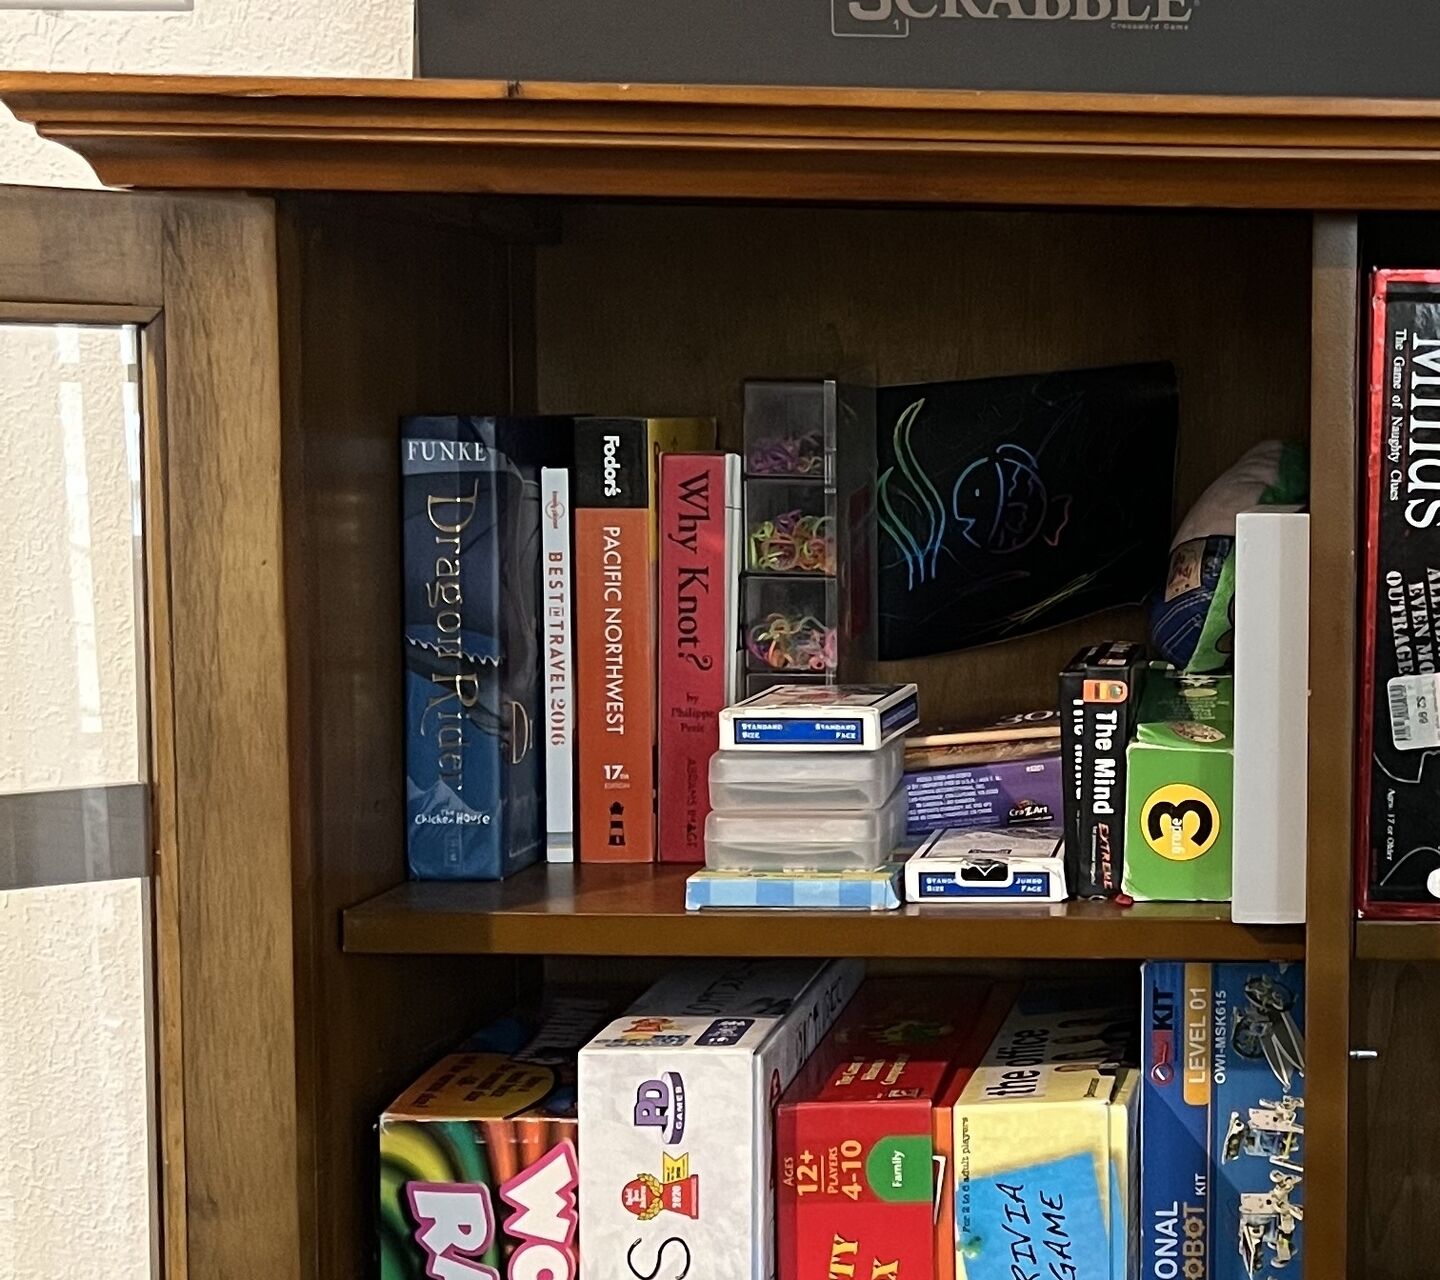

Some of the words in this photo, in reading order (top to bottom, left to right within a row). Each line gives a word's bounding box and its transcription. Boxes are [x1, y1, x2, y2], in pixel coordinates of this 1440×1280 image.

[408, 439, 487, 462] FUNKE
[603, 435, 622, 497] Fodor's
[668, 471, 711, 555] Why
[426, 478, 480, 658] Dragon
[548, 552, 564, 607] BEST
[603, 526, 622, 602] PACIFIC
[677, 566, 713, 671] Knot?
[549, 620, 566, 693] TRAVEL
[604, 608, 624, 735] NORTHWEST
[420, 673, 480, 791] Rider
[550, 698, 567, 746] 2016
[1095, 710, 1117, 751] The
[1093, 758, 1116, 815] Mind
[1148, 799, 1213, 847] 3
[1098, 822, 1113, 889] EXTREME
[1153, 986, 1174, 1031] KIT
[1189, 988, 1206, 1010] 01
[1189, 1016, 1206, 1084] LEVEL
[1214, 989, 1227, 1085] OWI-MSK615
[783, 1157, 794, 1187] AGES
[797, 1150, 818, 1196] 12+
[827, 1146, 838, 1194] PLAYERS
[841, 1140, 862, 1200] 4-10
[891, 1150, 905, 1188] Family
[1195, 1173, 1206, 1196] KIT
